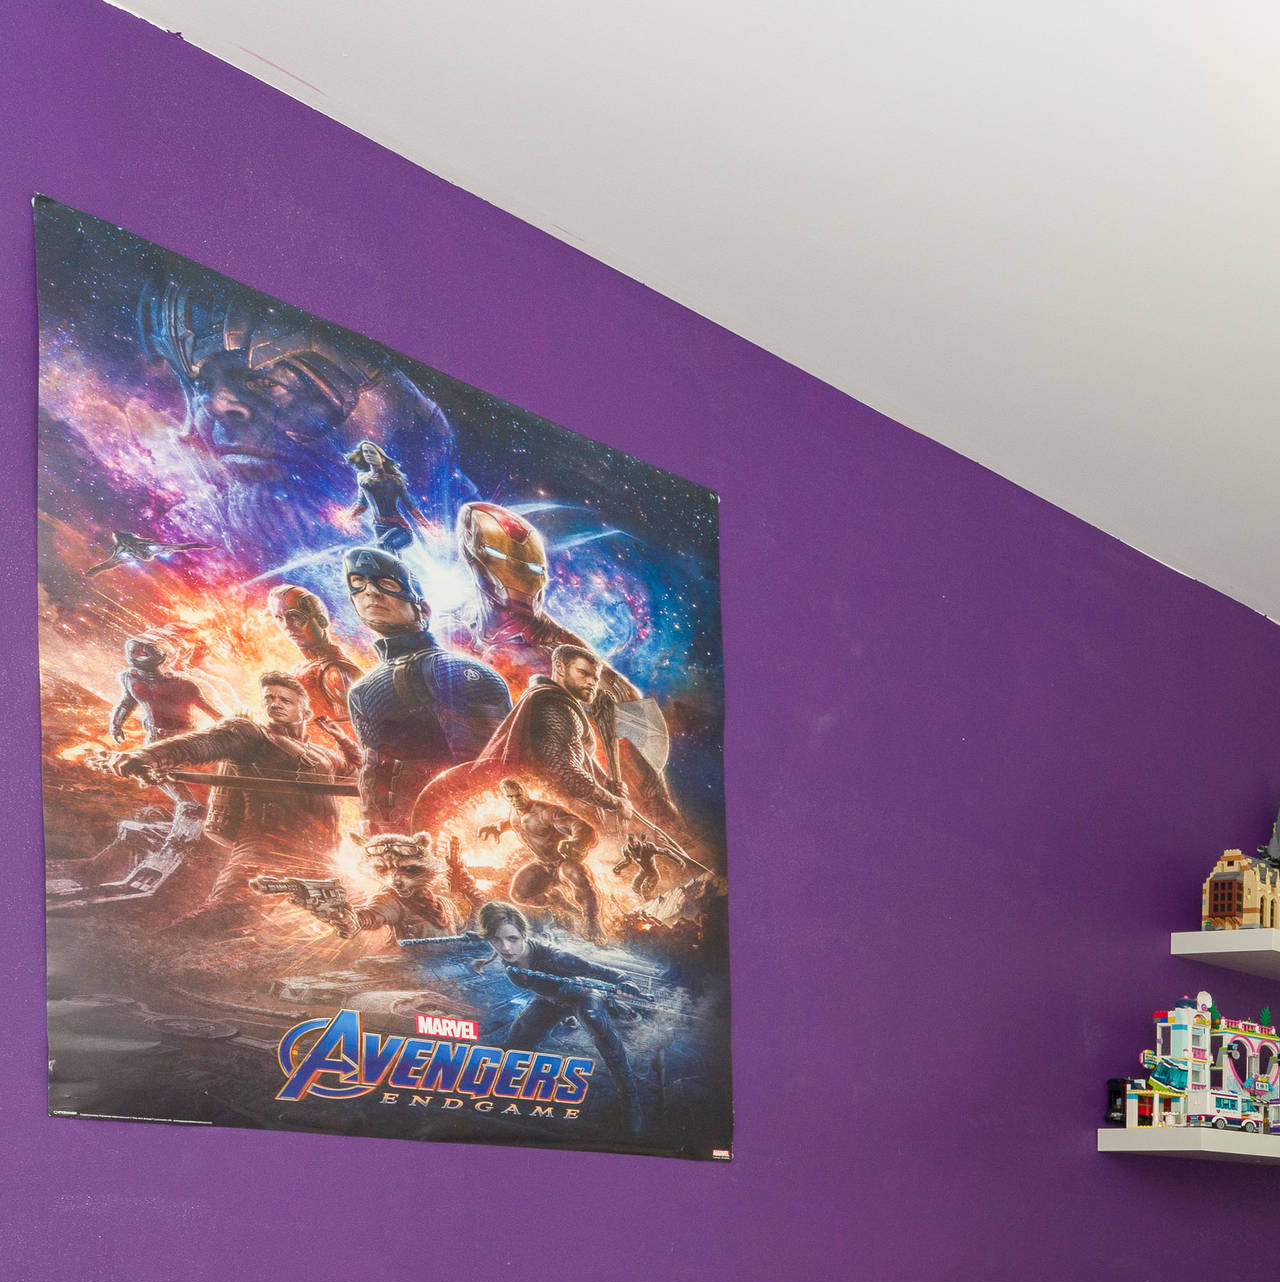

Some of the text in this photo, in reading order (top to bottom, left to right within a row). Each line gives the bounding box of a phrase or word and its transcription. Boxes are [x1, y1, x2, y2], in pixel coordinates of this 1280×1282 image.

[417, 1015, 478, 1040] MARVEL
[275, 1009, 595, 1104] AVENGERS
[380, 1092, 580, 1119] ENDGAME
